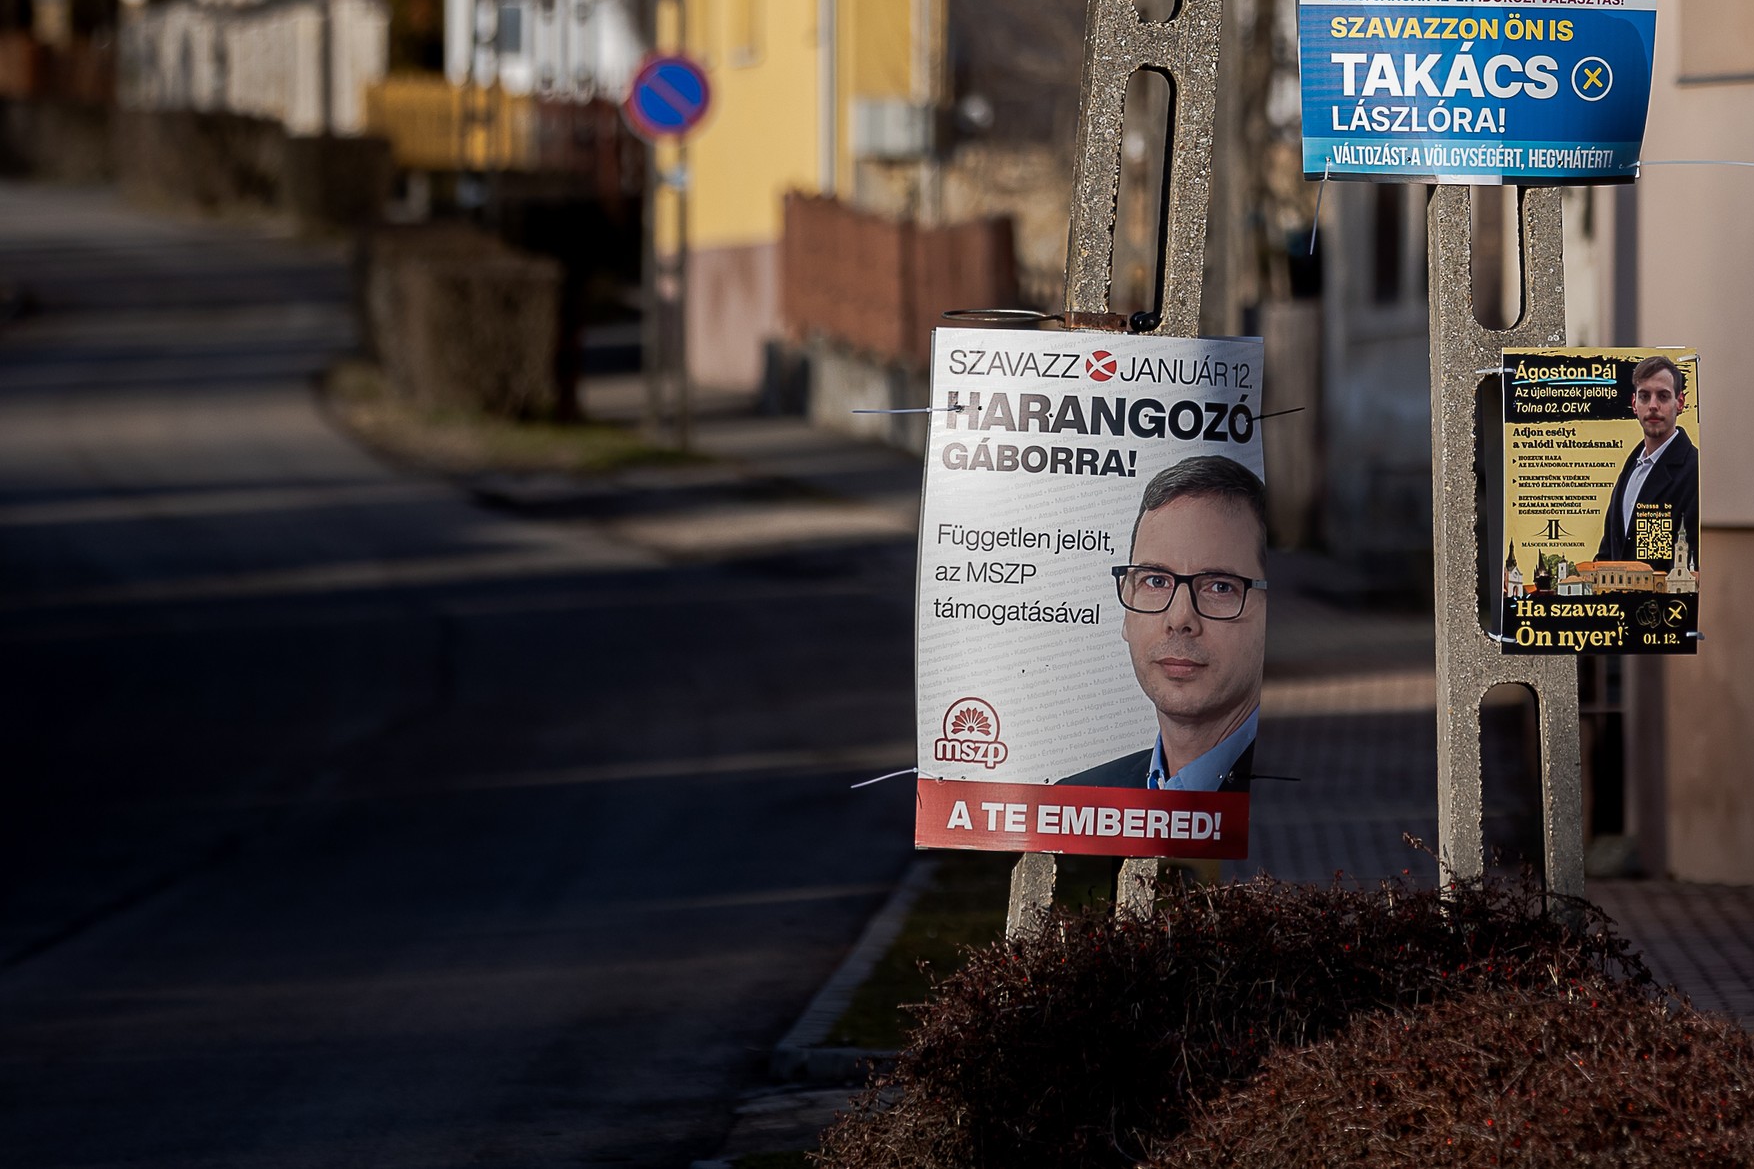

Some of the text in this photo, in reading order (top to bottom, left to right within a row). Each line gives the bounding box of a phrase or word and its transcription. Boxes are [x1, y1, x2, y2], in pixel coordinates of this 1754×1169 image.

[1330, 12, 1574, 41] SZAVAZZON ÖN IS
[1331, 40, 1559, 99] TAKÁCS
[1331, 99, 1506, 134] LÁSZLÓRA!
[1333, 143, 1613, 170] VÁLTOZÁST A VÖLGYSÉGÉRT, HEGYHÁTÉRT!
[949, 348, 1080, 380] SZAVAZZ
[1120, 354, 1229, 388] JANUÁR
[1231, 363, 1253, 390] 12.
[1515, 360, 1617, 383] Ágoston Pál
[1515, 386, 1618, 399] Az újellenzék jelöltje
[1516, 402, 1591, 413] Tolna 02. OEVK
[946, 389, 1254, 445] HARANGOZÓ
[1513, 427, 1577, 438] Adjon esélyt
[1521, 439, 1554, 449] valódi
[1556, 439, 1624, 449] változásnak!
[942, 437, 1138, 478] GÁBORRA!
[937, 522, 1115, 555] Független jelölt,
[935, 561, 1037, 585] az MSZP
[933, 595, 1100, 626] támogatásával
[1516, 600, 1625, 620] Ha szavaz,
[1515, 620, 1624, 652] Ön nyer!
[1643, 633, 1680, 645] 01. 12.
[936, 737, 1008, 769] mszp
[946, 801, 1222, 841] A TE EMBERED!
